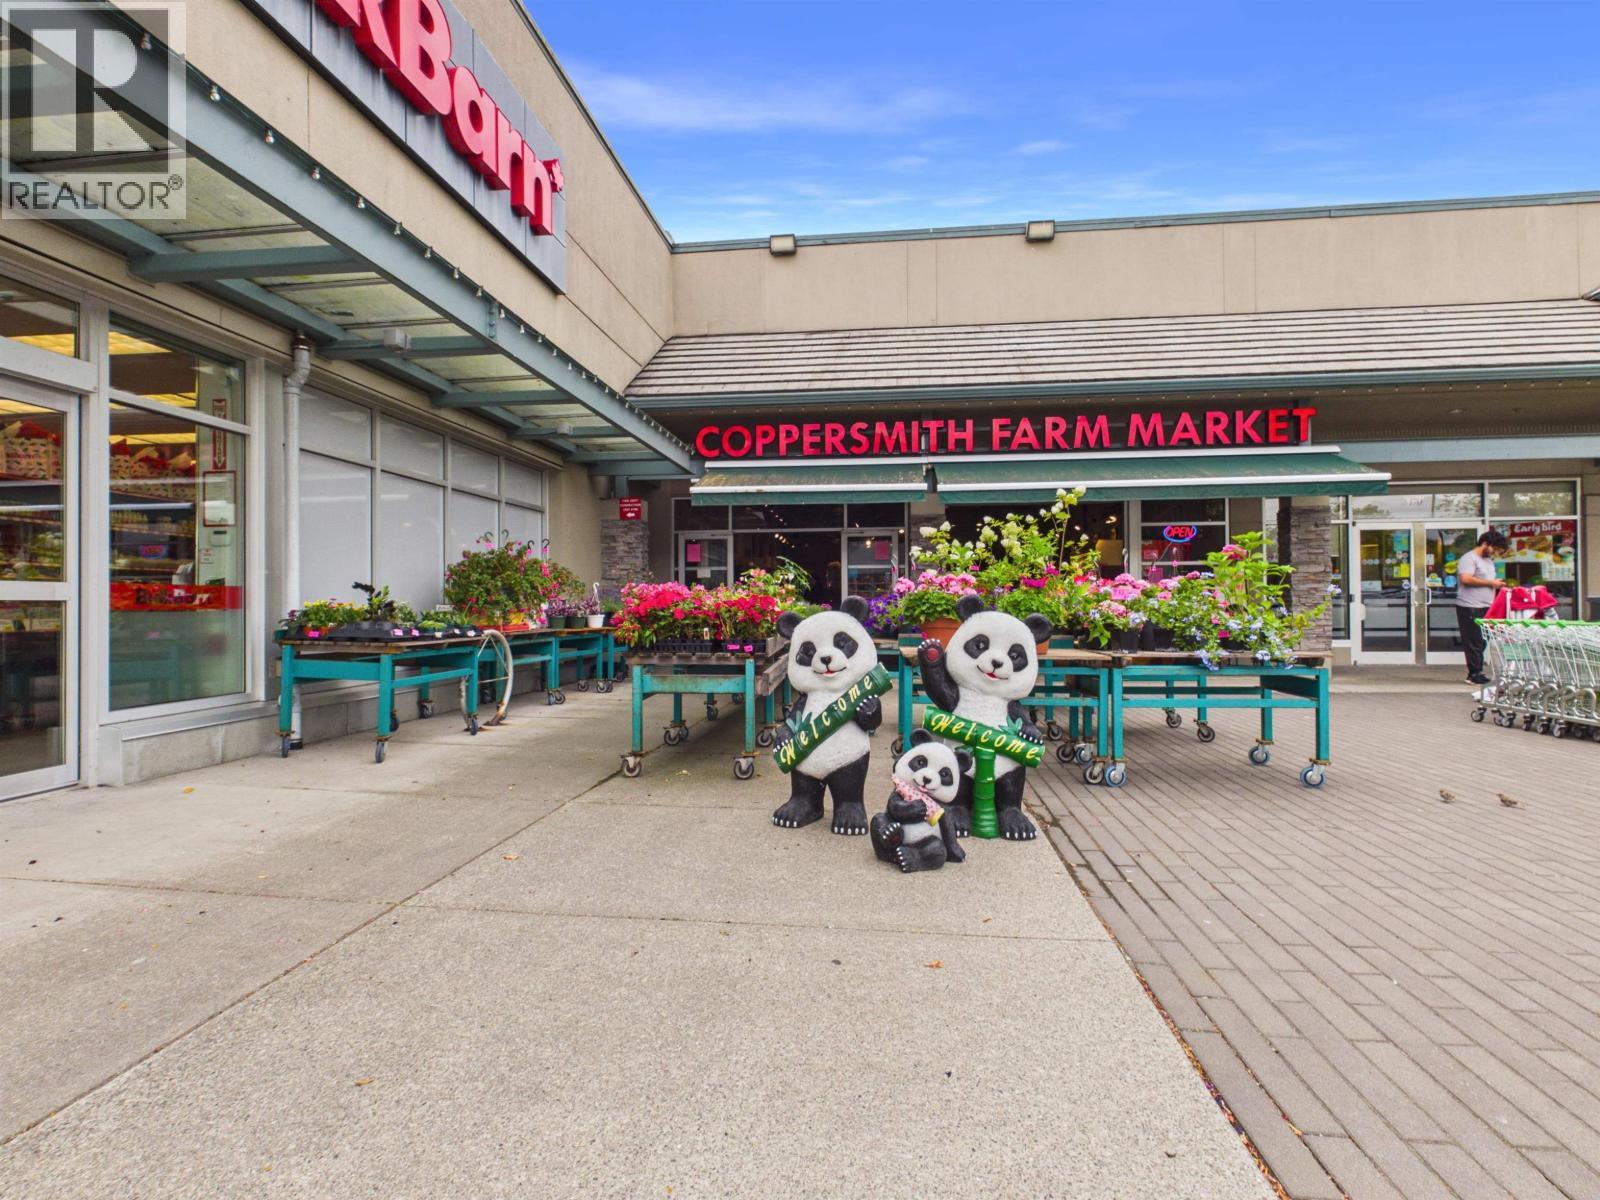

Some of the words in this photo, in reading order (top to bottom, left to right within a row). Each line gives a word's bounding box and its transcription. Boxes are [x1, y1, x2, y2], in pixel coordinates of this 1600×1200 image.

[695, 419, 974, 458] COPPERSMITH
[992, 415, 1112, 450] FARM
[1127, 407, 1316, 447] MARKET
[1166, 526, 1193, 538] OPEN
[780, 675, 872, 765] Welcome
[931, 713, 1039, 759] Welcome
